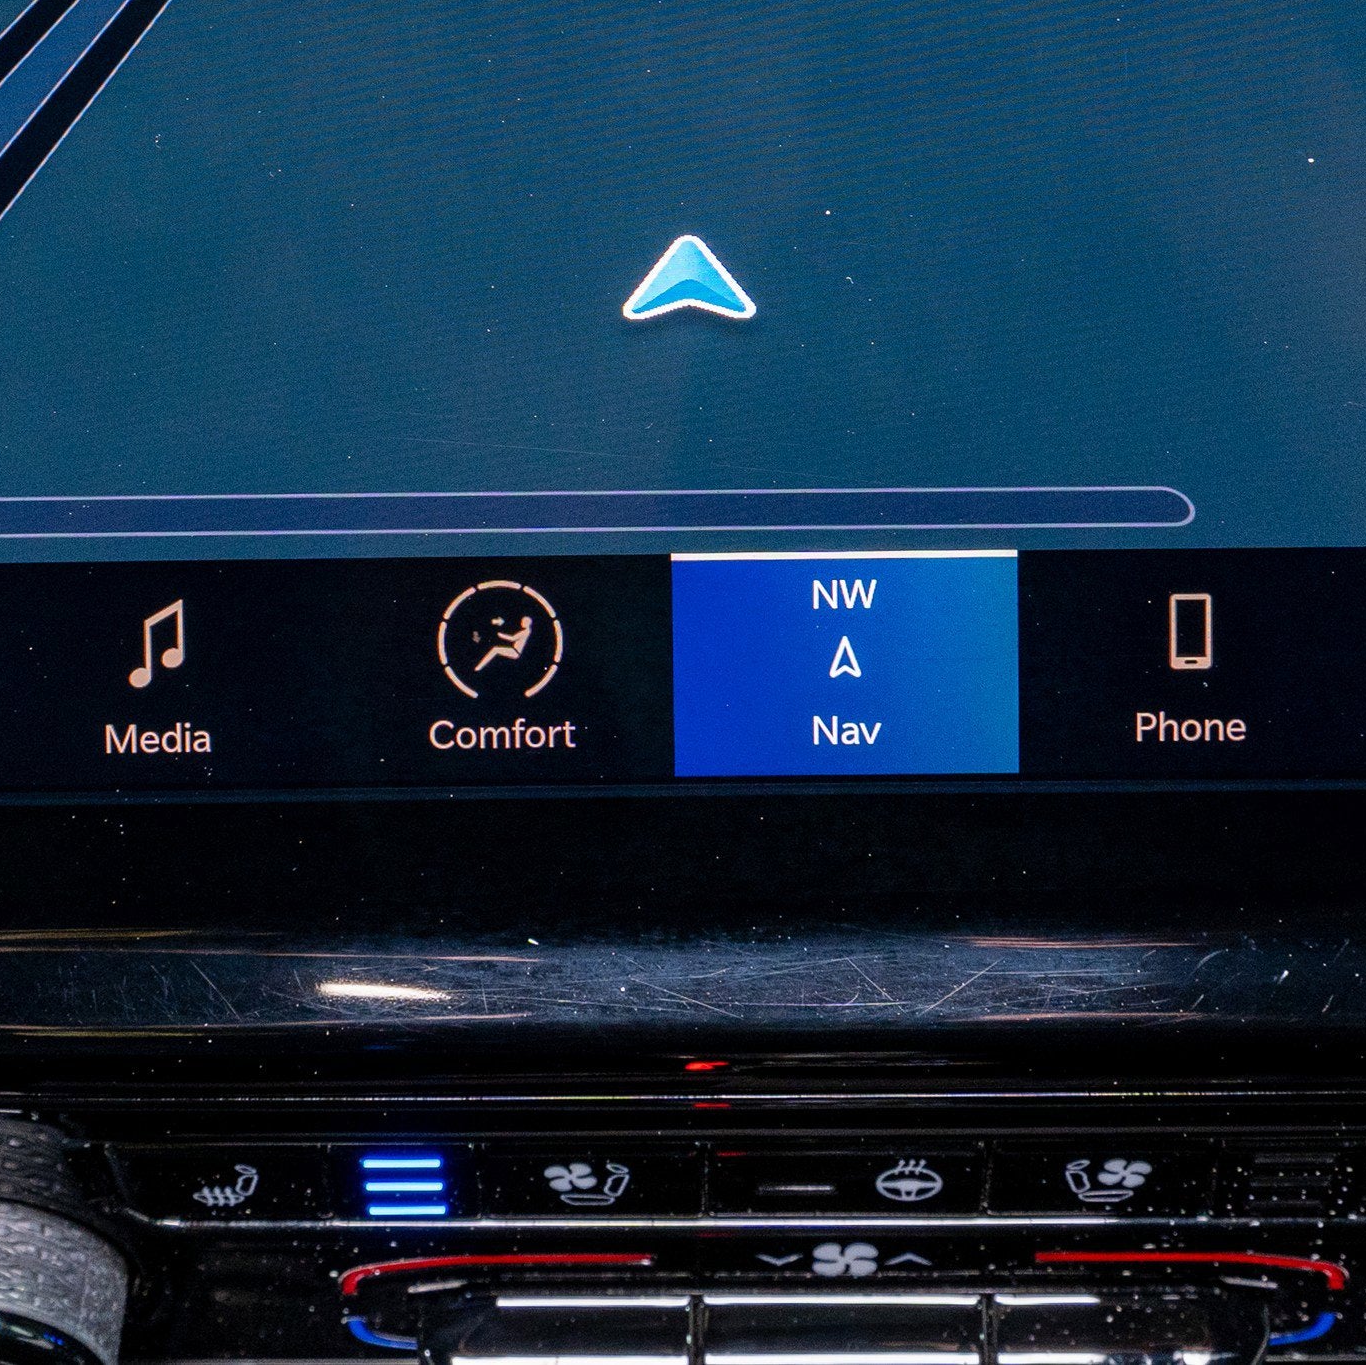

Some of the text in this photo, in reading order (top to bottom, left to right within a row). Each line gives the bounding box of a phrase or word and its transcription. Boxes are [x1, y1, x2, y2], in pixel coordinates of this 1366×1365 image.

[813, 579, 876, 609] NW
[106, 722, 211, 753] Media
[430, 718, 575, 749] Comfort
[813, 716, 881, 745] Nav
[1137, 711, 1246, 741] Phone
